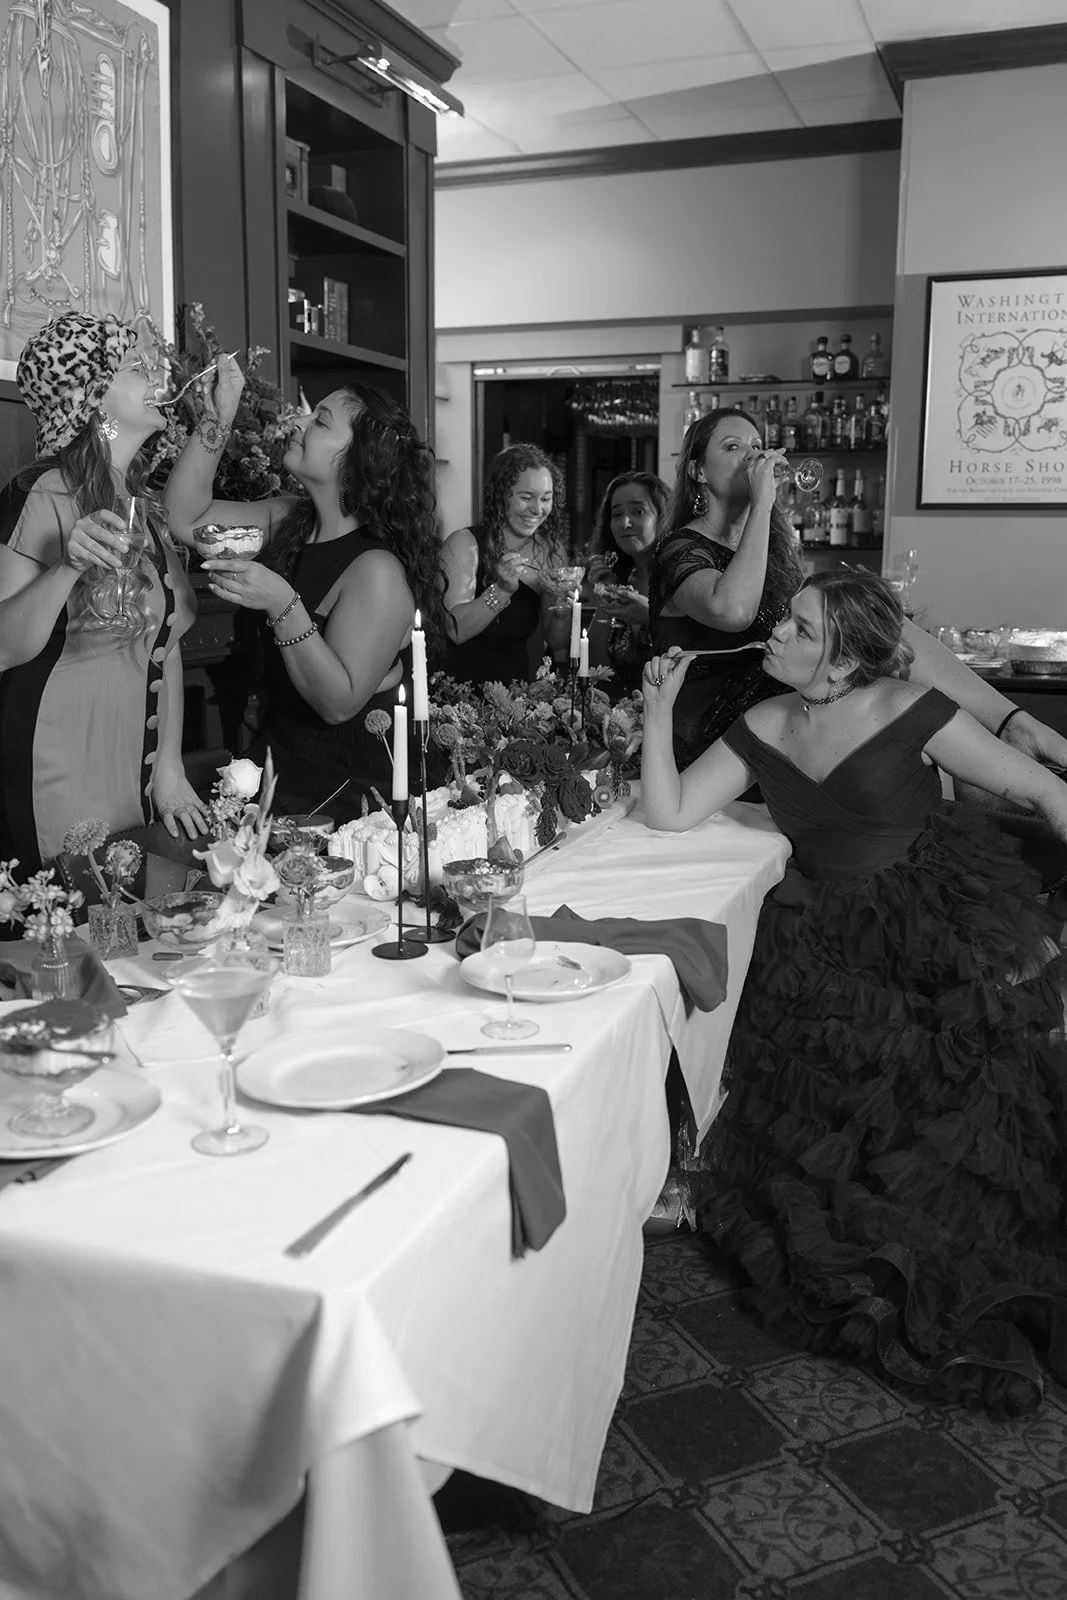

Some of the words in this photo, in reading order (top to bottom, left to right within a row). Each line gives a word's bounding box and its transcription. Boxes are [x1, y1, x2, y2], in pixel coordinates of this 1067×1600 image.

[957, 292, 1064, 308] WASHINGT
[949, 460, 1013, 474] HORSE
[1025, 459, 1065, 473] SHO
[1041, 475, 1062, 485] 1998
